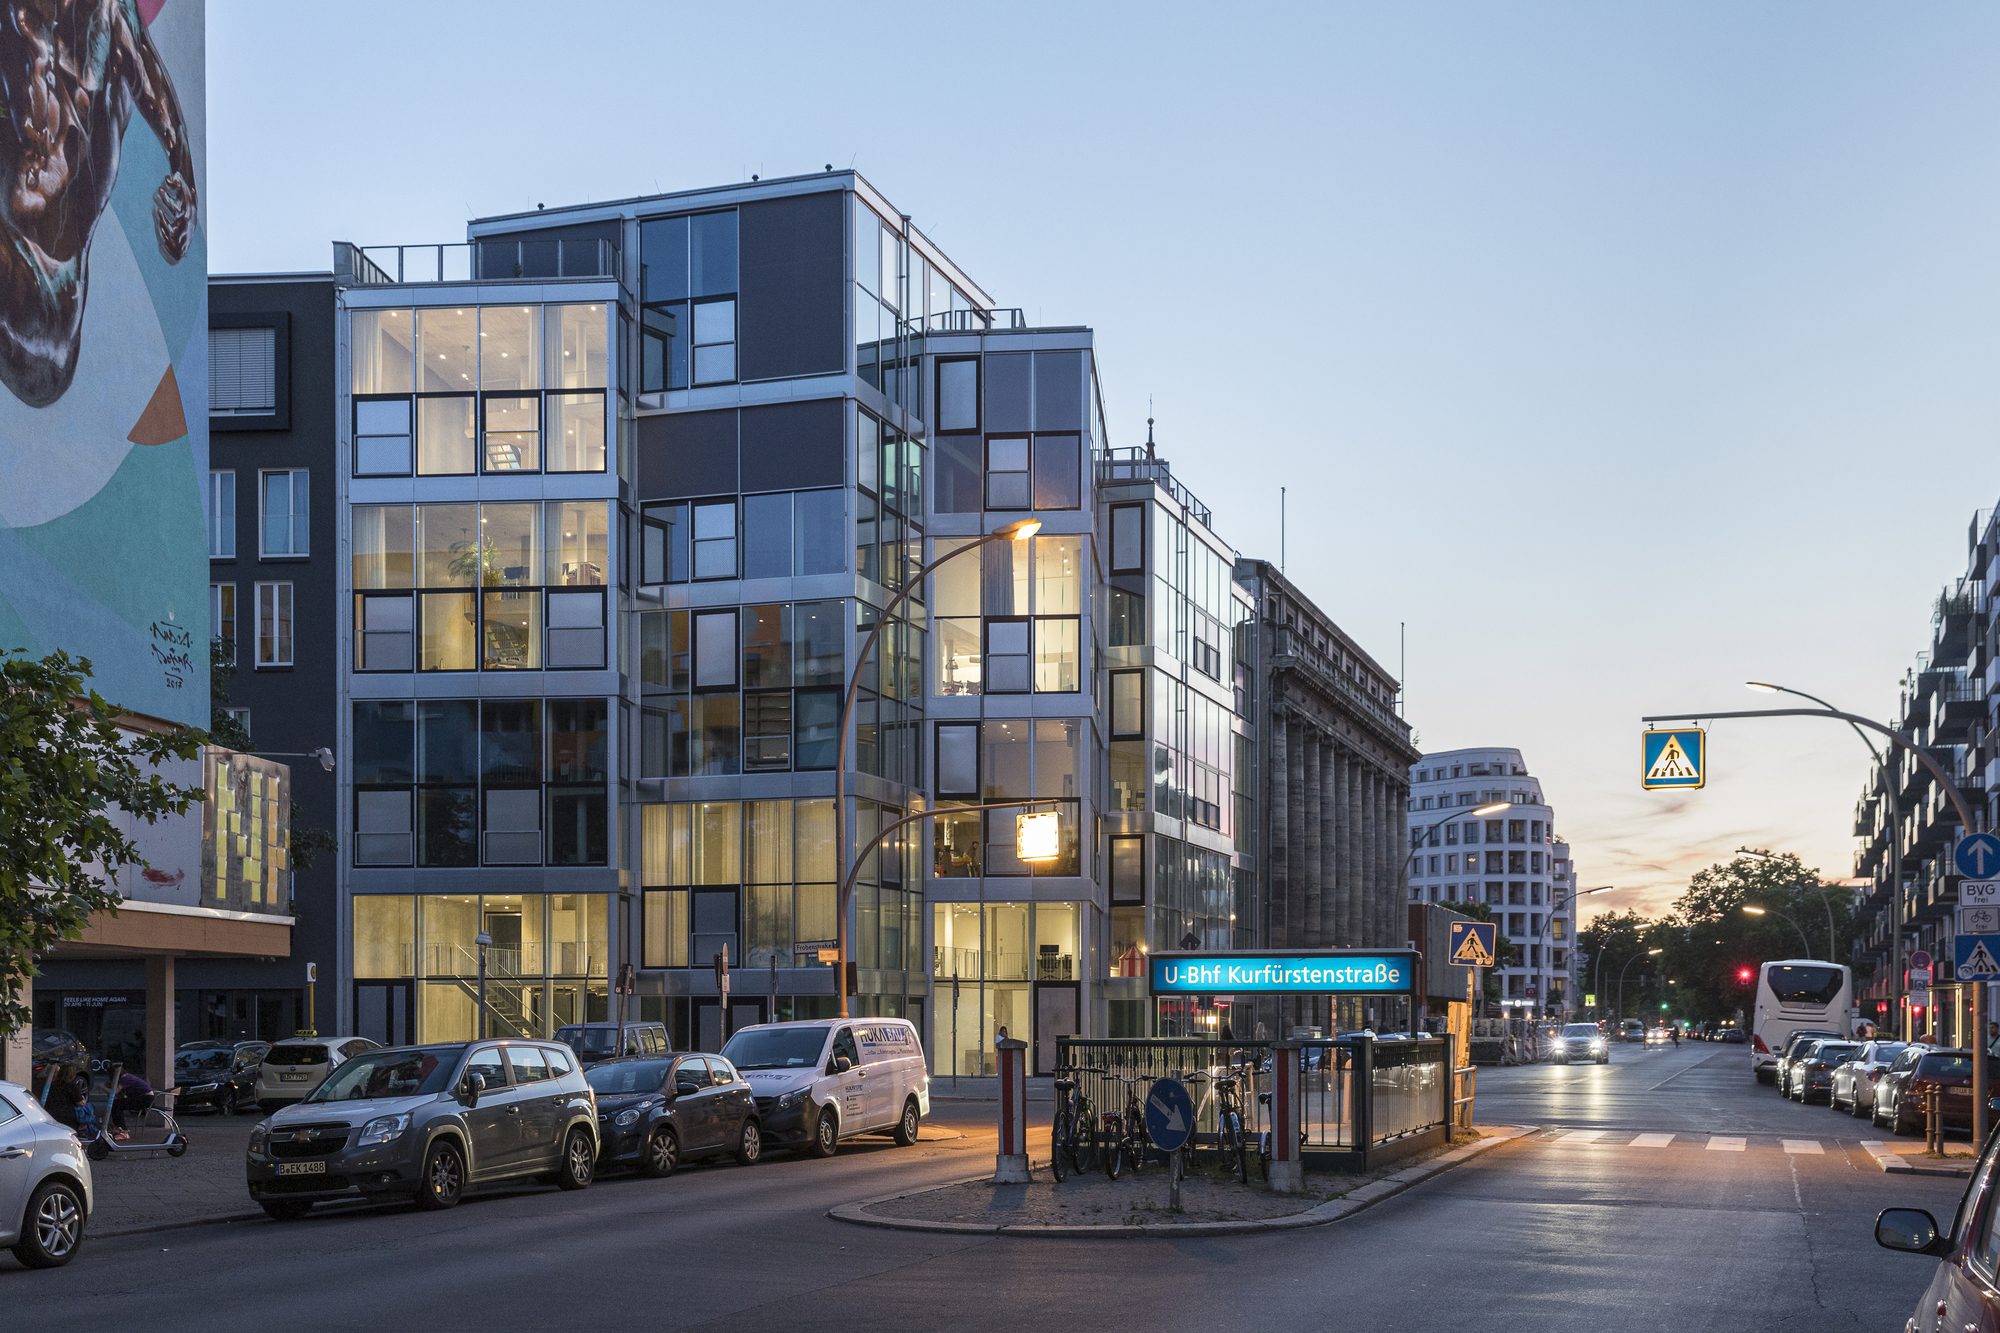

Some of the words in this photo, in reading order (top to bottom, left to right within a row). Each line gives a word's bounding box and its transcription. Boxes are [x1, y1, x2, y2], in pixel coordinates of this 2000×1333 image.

[166, 678, 182, 689] 2017
[1966, 884, 1996, 896] BVG
[1974, 896, 1989, 904] frei
[1165, 965, 1221, 985] U-Bhf
[1228, 963, 1401, 985] Kurfürstenstraße
[887, 1027, 903, 1041] BAU
[280, 1164, 285, 1174] B
[290, 1163, 302, 1173] EK
[303, 1162, 324, 1173] 1488
